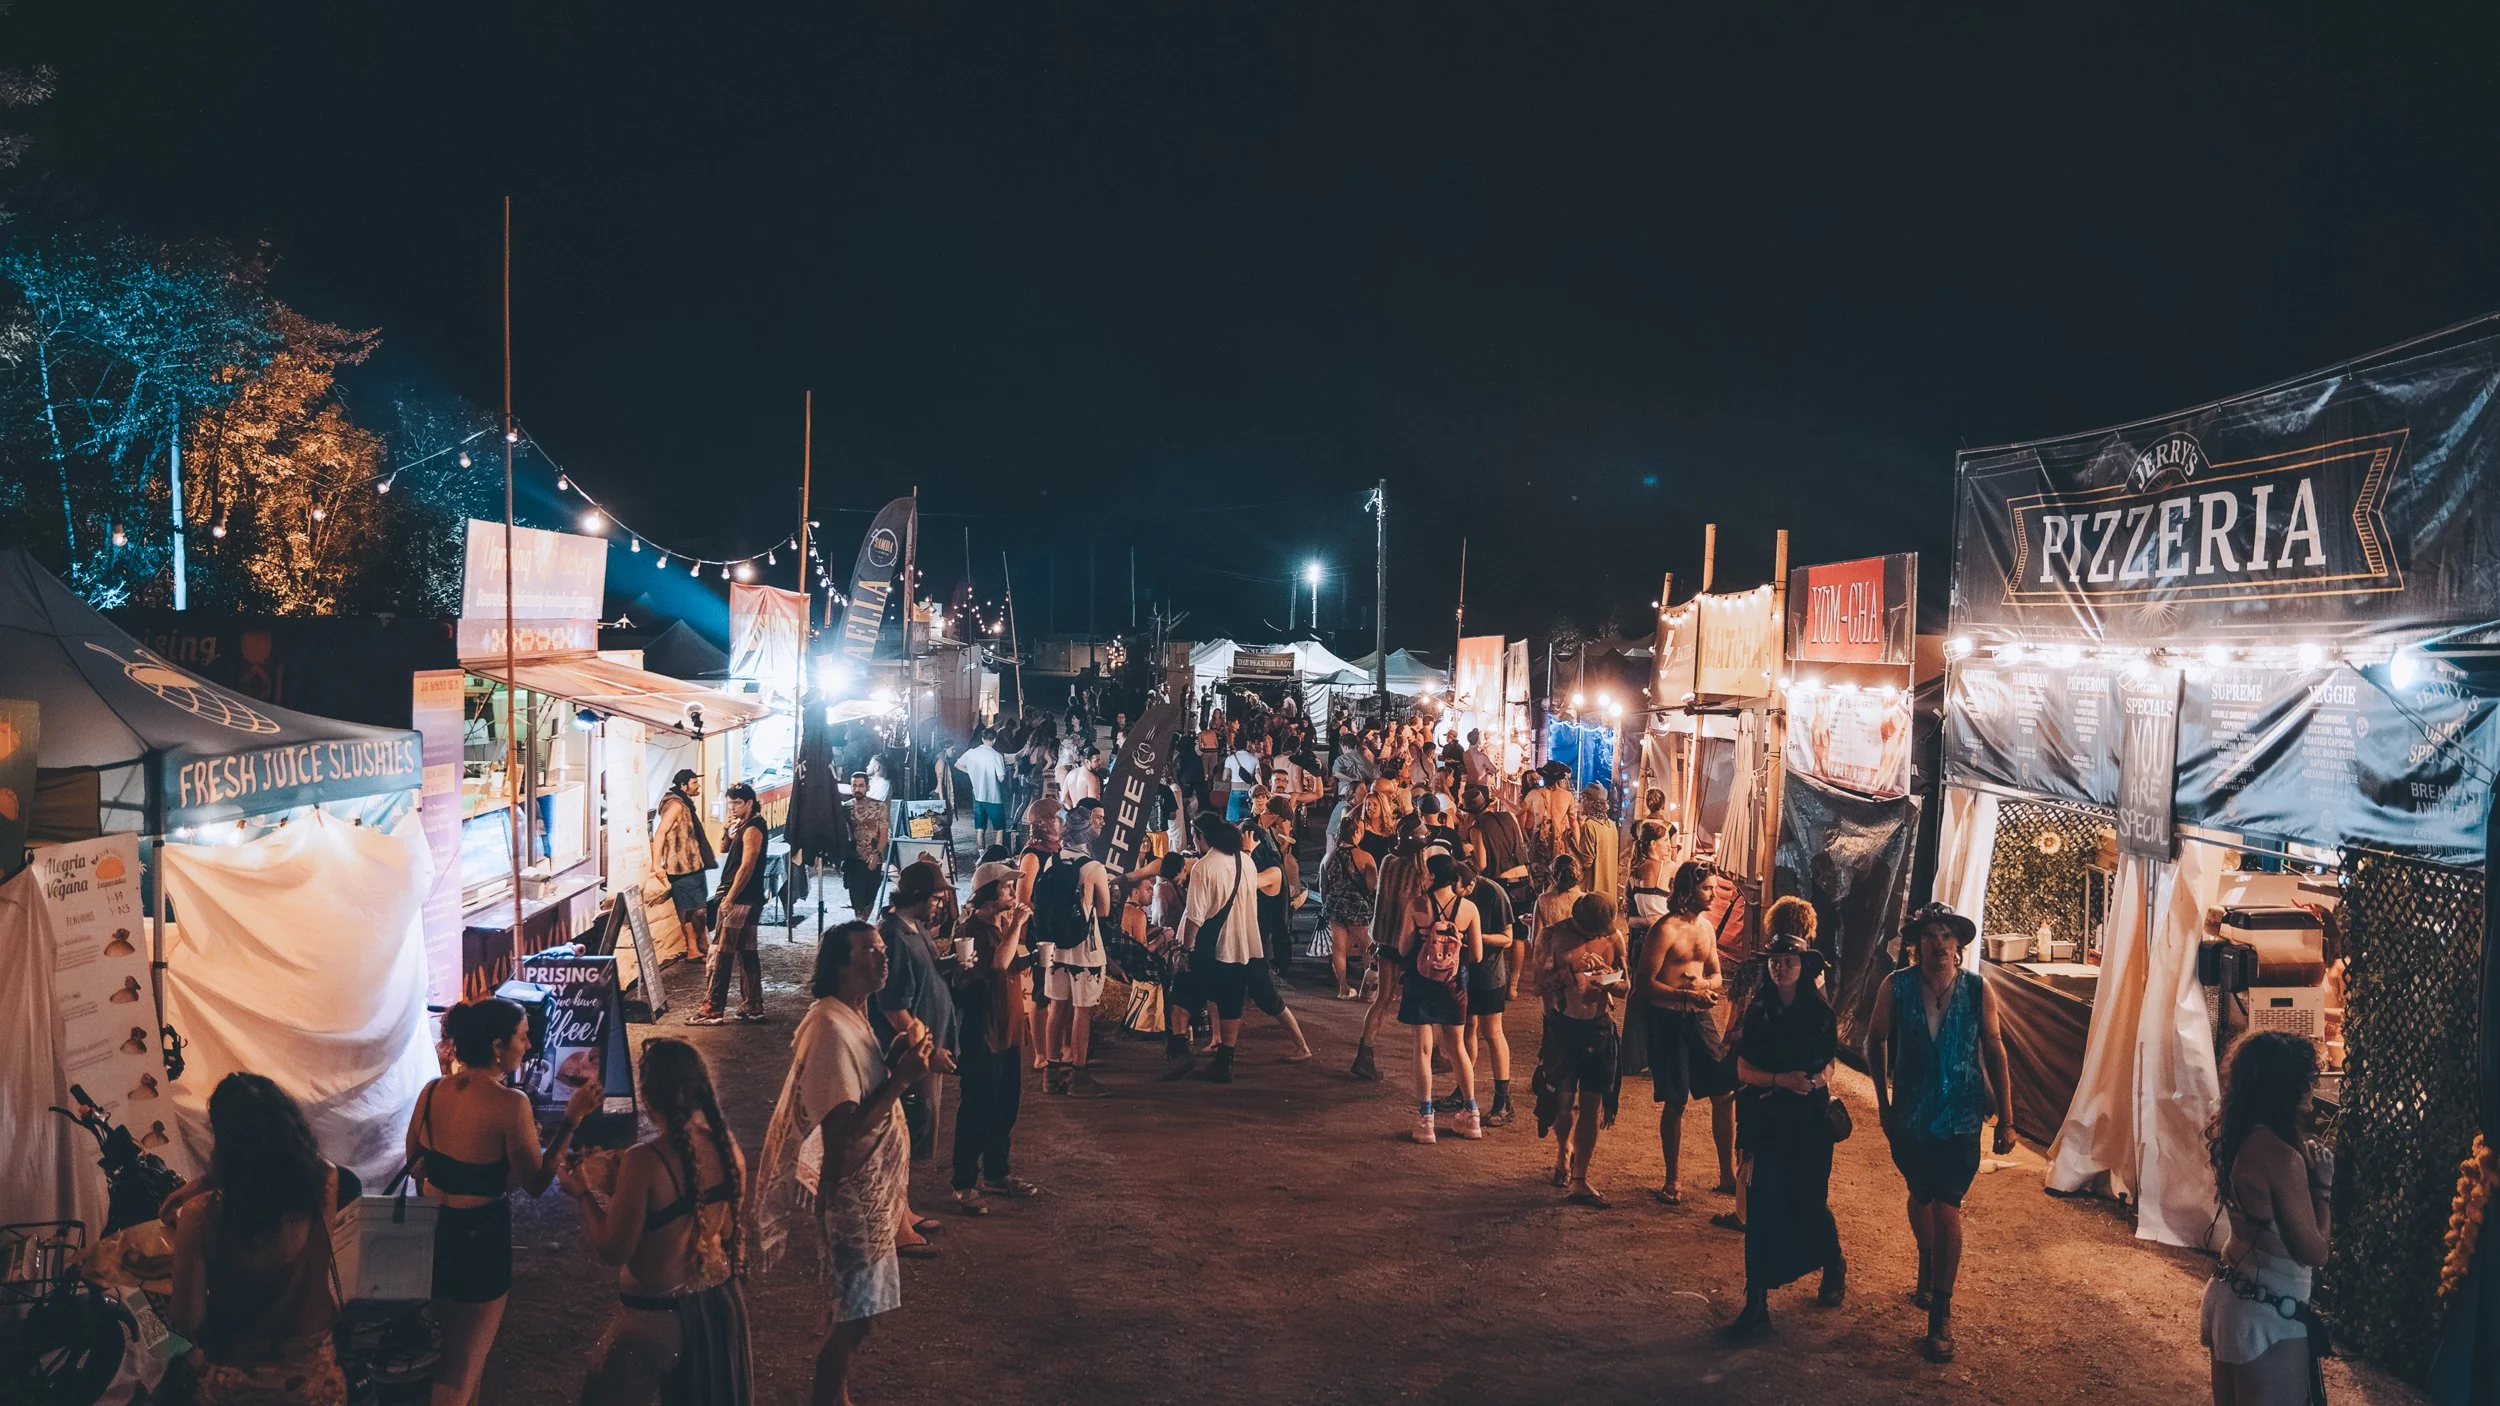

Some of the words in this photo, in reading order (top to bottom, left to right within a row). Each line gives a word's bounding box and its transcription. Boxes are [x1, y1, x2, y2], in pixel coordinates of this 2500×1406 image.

[2136, 439, 2198, 490] JERRY'S
[2040, 478, 2326, 583] PIZZERIA
[842, 578, 891, 664] AELLA
[1811, 580, 1879, 644] YOM-CHA
[1237, 658, 1250, 666] THE
[1250, 659, 1276, 667] FEATHER
[1276, 660, 1292, 668] LADY
[2066, 675, 2110, 693] PEPPERONI
[2211, 684, 2263, 702] SUPREME
[2307, 685, 2357, 706] VEGGIE
[2125, 697, 2173, 717] SPECIALS
[2131, 717, 2169, 775] YOU
[179, 755, 257, 809] FRESH
[262, 744, 325, 792] JUICE
[329, 740, 415, 781] SLUSHIES
[2129, 777, 2161, 808] ARE
[2410, 782, 2481, 805] BREAKFAST
[2415, 801, 2440, 817] AND
[2119, 808, 2169, 846] SPECIAL
[44, 853, 86, 876] Alegria
[44, 877, 89, 902] Vegana
[573, 989, 597, 1008] have
